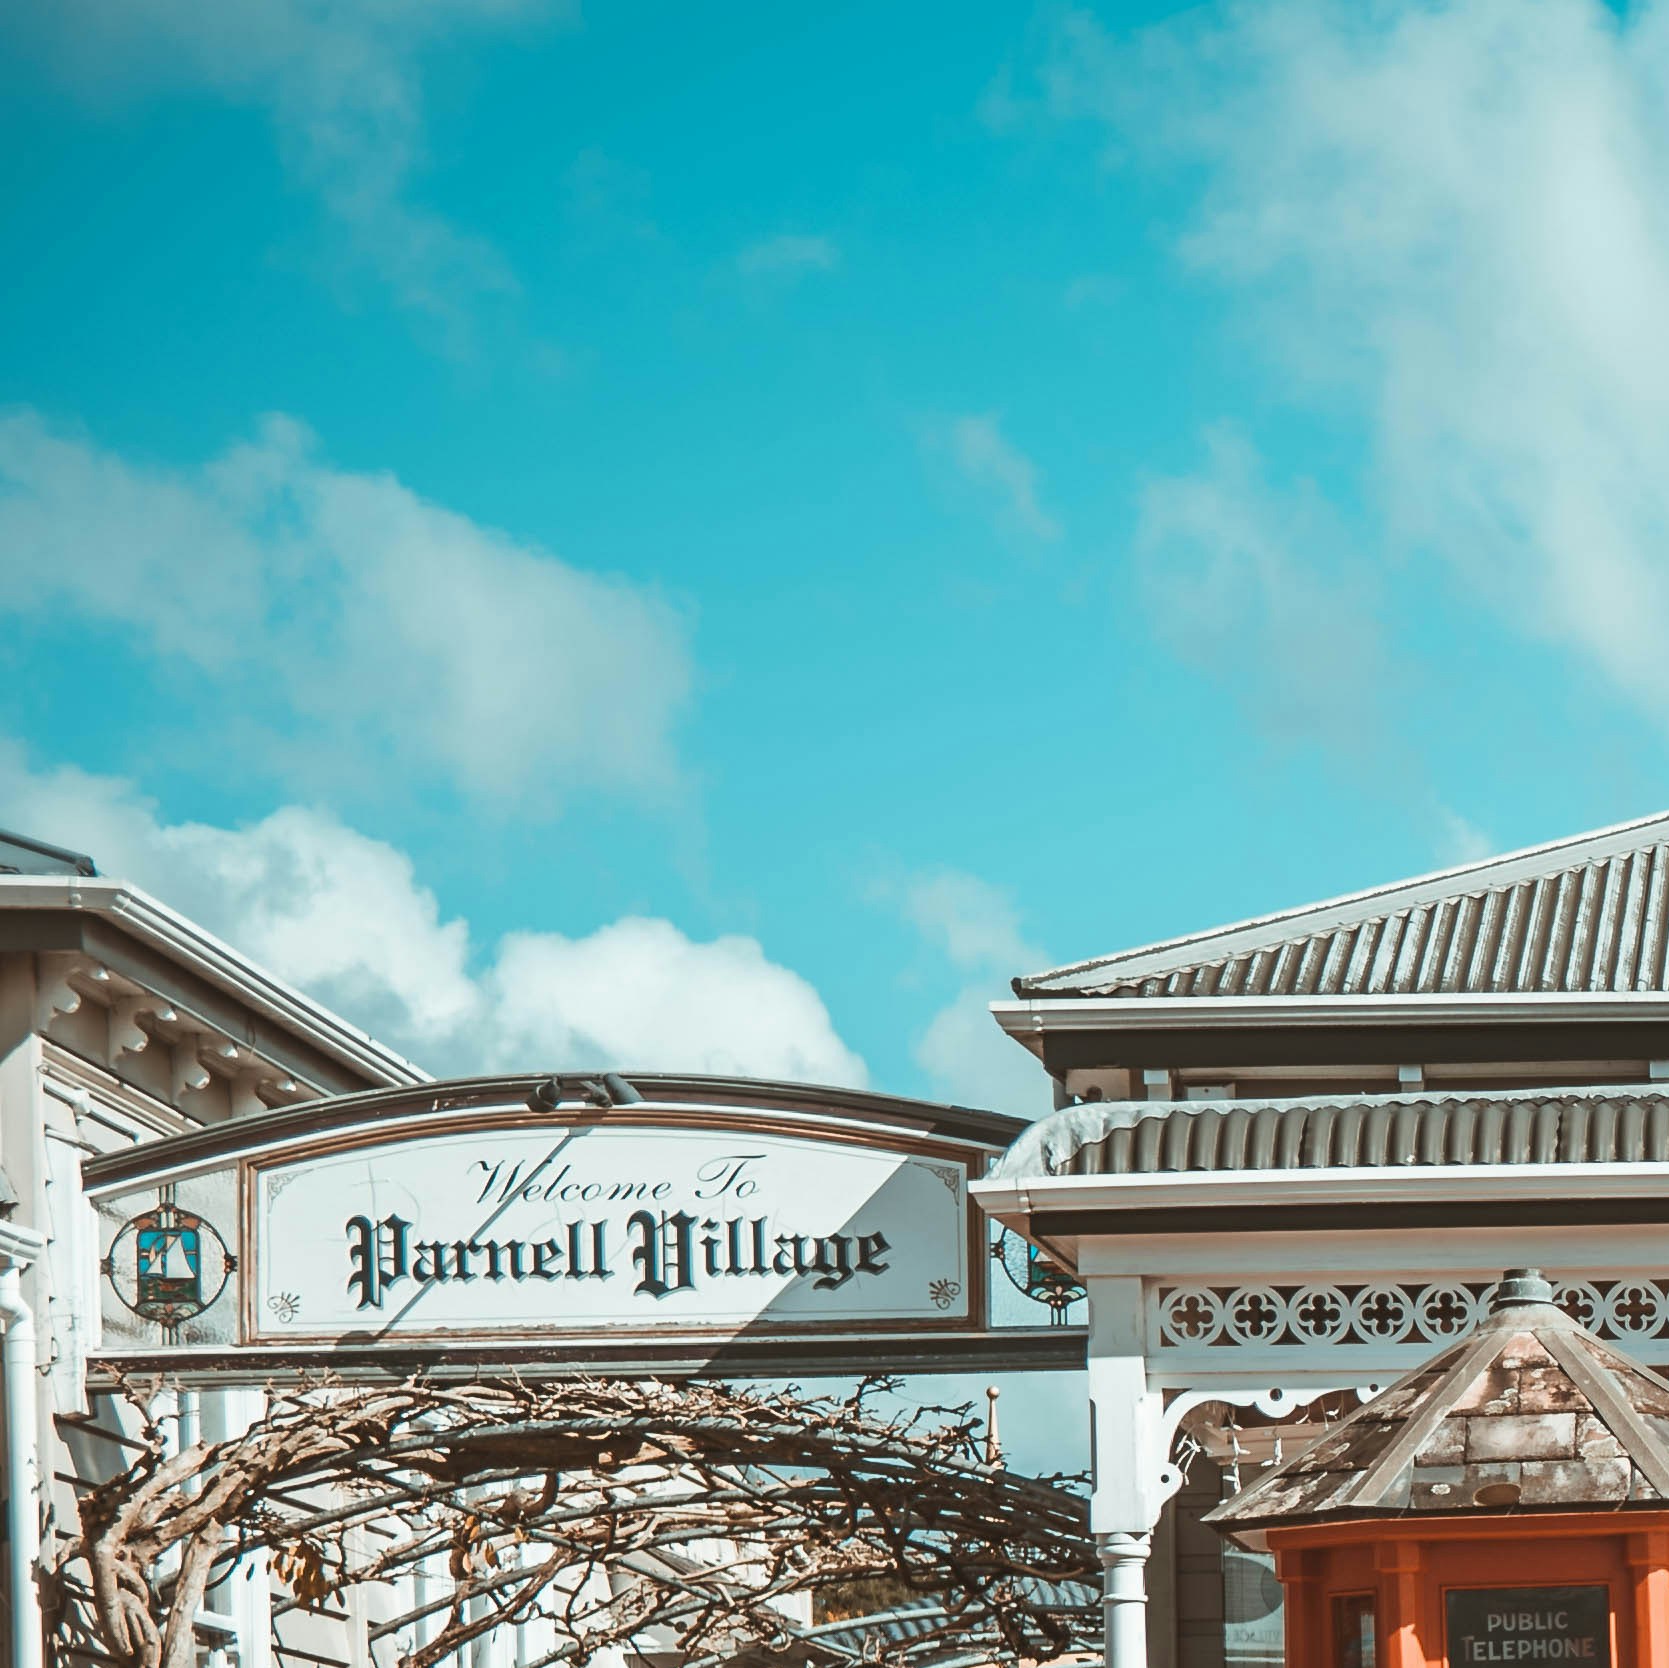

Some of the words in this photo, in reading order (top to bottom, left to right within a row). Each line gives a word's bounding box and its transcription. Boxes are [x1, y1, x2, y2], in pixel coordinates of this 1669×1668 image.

[468, 1158, 674, 1207] Welcome
[693, 1154, 768, 1200] To
[346, 1212, 615, 1311] Parnell
[627, 1209, 891, 1300] Village
[1487, 1611, 1569, 1632] PUBLIC
[1461, 1635, 1596, 1662] TELEPHONE
